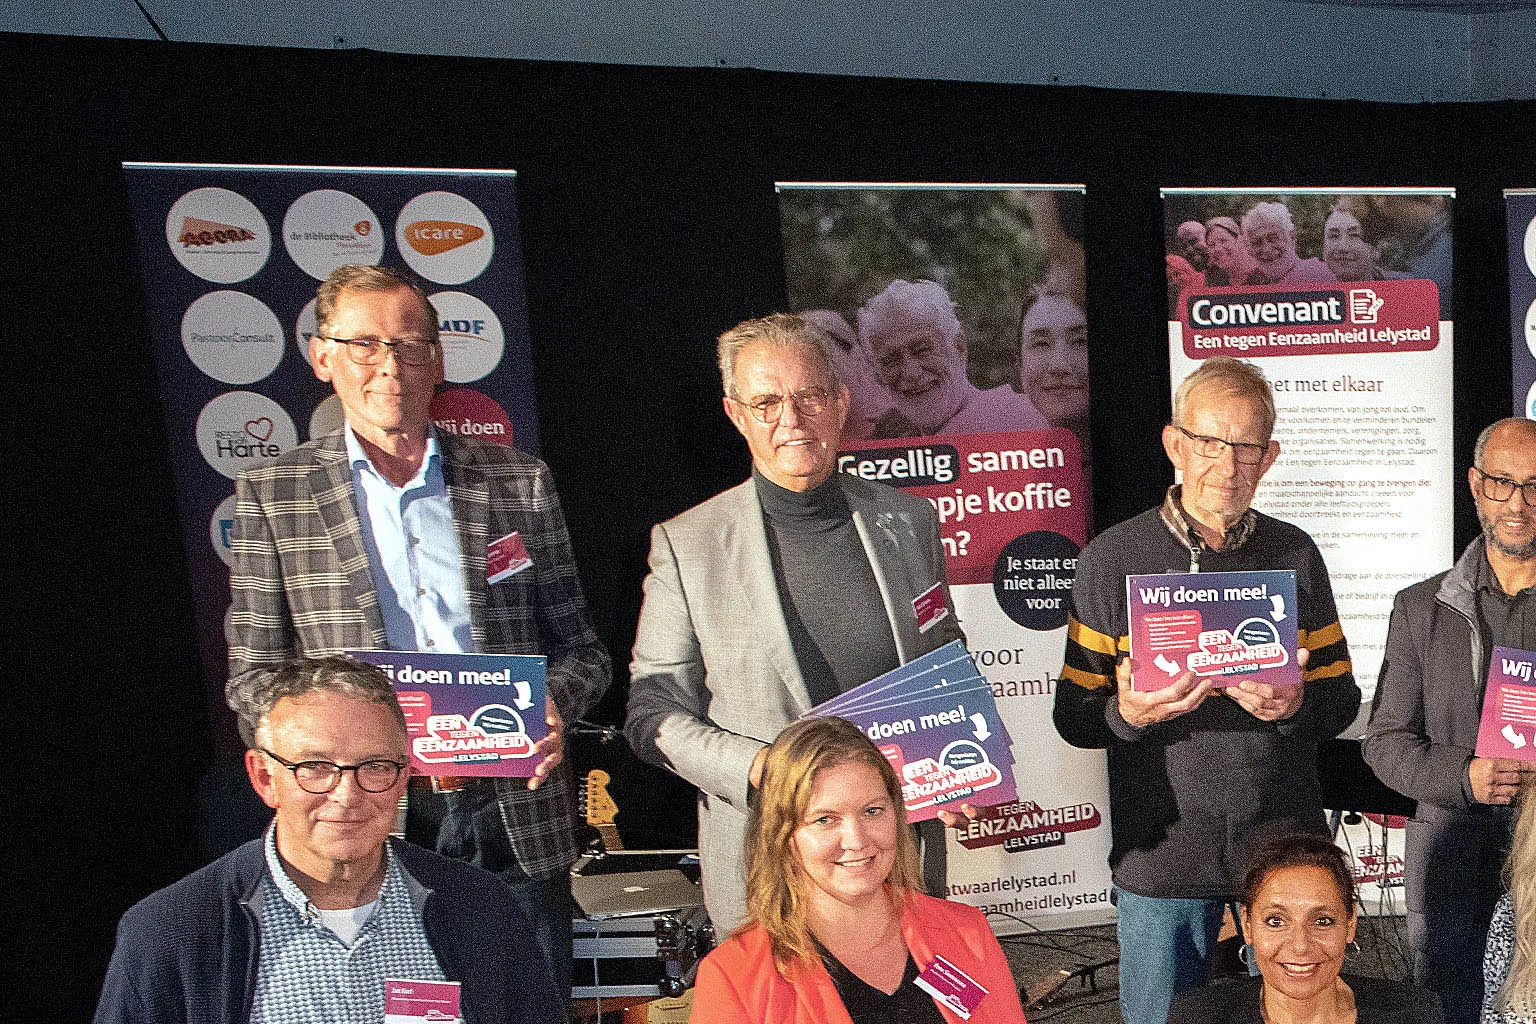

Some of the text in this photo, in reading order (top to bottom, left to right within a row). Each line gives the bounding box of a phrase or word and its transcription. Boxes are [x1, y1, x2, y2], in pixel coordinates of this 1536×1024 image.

[1192, 296, 1343, 327] Convenant
[1194, 324, 1431, 351] Een tegen Eenzaamheid Lelystad
[1295, 377, 1329, 393] met
[1332, 375, 1384, 393] elkaar
[461, 419, 505, 435] doen
[216, 440, 280, 457] Harte
[968, 448, 1065, 473] samen
[928, 483, 1071, 522] pje koffie
[1007, 557, 1078, 571] Je staat er
[1004, 576, 1076, 590] niet allee
[1026, 596, 1062, 609] voor
[1139, 584, 1267, 607] Wij doen mee!
[1203, 634, 1227, 645] EEN
[973, 648, 1024, 666] voor
[1192, 646, 1280, 667] EENZAAMHEID
[397, 665, 510, 686] doen mee!
[1501, 658, 1532, 681] Wij
[433, 718, 462, 731] EEN
[867, 705, 966, 740] doen mee!
[417, 737, 525, 752] EENZAAMHEID
[996, 802, 1034, 816] TEGEN
[956, 803, 1094, 842] EENZAAMHEID
[1004, 831, 1062, 849] LELYSTAD
[946, 870, 1076, 896] atwaarlelystad.nl
[977, 889, 1107, 915] aamheidlelystad
